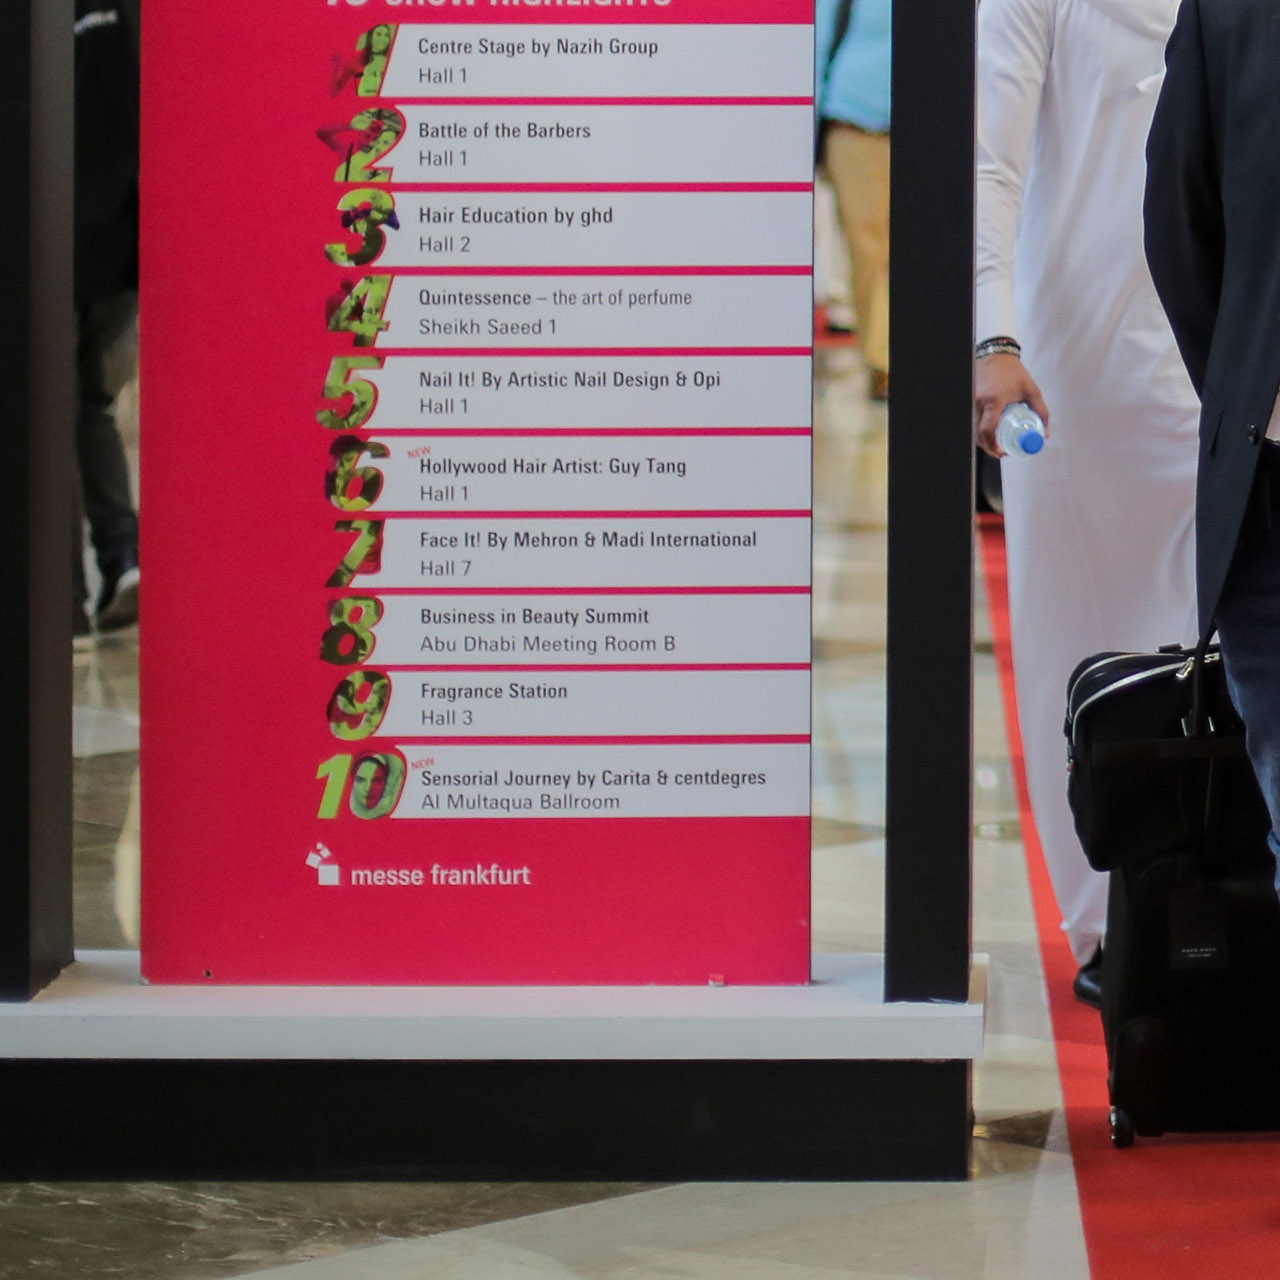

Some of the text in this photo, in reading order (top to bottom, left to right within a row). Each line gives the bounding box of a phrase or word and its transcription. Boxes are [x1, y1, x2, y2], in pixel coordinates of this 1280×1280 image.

[418, 37, 659, 58] Centre Stage by Nazih Group
[356, 24, 399, 96] 1
[418, 67, 467, 84] Hall 1
[419, 122, 591, 139] Battle of the Barbers
[334, 107, 404, 182] 2
[418, 149, 467, 167] Hall 1
[324, 188, 396, 266] 3
[419, 206, 613, 228] Hair Education by ghd
[419, 235, 471, 253] Hall 2
[419, 288, 532, 306] Quintessence
[552, 289, 577, 306] the
[582, 291, 603, 306] art
[608, 288, 623, 306] of
[628, 288, 692, 309] perfume
[327, 275, 393, 347] 4
[419, 318, 556, 336] Sheikh Saeed 1
[419, 370, 721, 391] Nail It! By Artistic Nail Design & Opi
[316, 356, 386, 429] 5
[419, 397, 468, 415] Hall 1
[407, 445, 431, 459] NEW
[328, 435, 390, 511] 6
[420, 457, 686, 478] Hollywood Hair Artist: Guy Tang
[420, 485, 468, 502] Hall 1
[420, 530, 757, 551] Face It! By Mehron & Madi International
[325, 520, 382, 587] 7
[420, 560, 472, 577] Hall 7
[421, 607, 649, 627] Business in Beauty Summit
[320, 596, 383, 665] 8
[420, 635, 676, 656] Abu Dhabi Meeting Room B
[421, 682, 568, 703] Fragrance Station
[327, 671, 391, 740] 9
[421, 709, 473, 726] Hall 3
[411, 756, 434, 769] NEW
[316, 750, 404, 819] 10
[420, 769, 767, 789] Sensorial Journey by Carita & centdegres
[421, 793, 620, 813] Al Multaqua Ballroom
[351, 863, 532, 886] messe frankfurt
